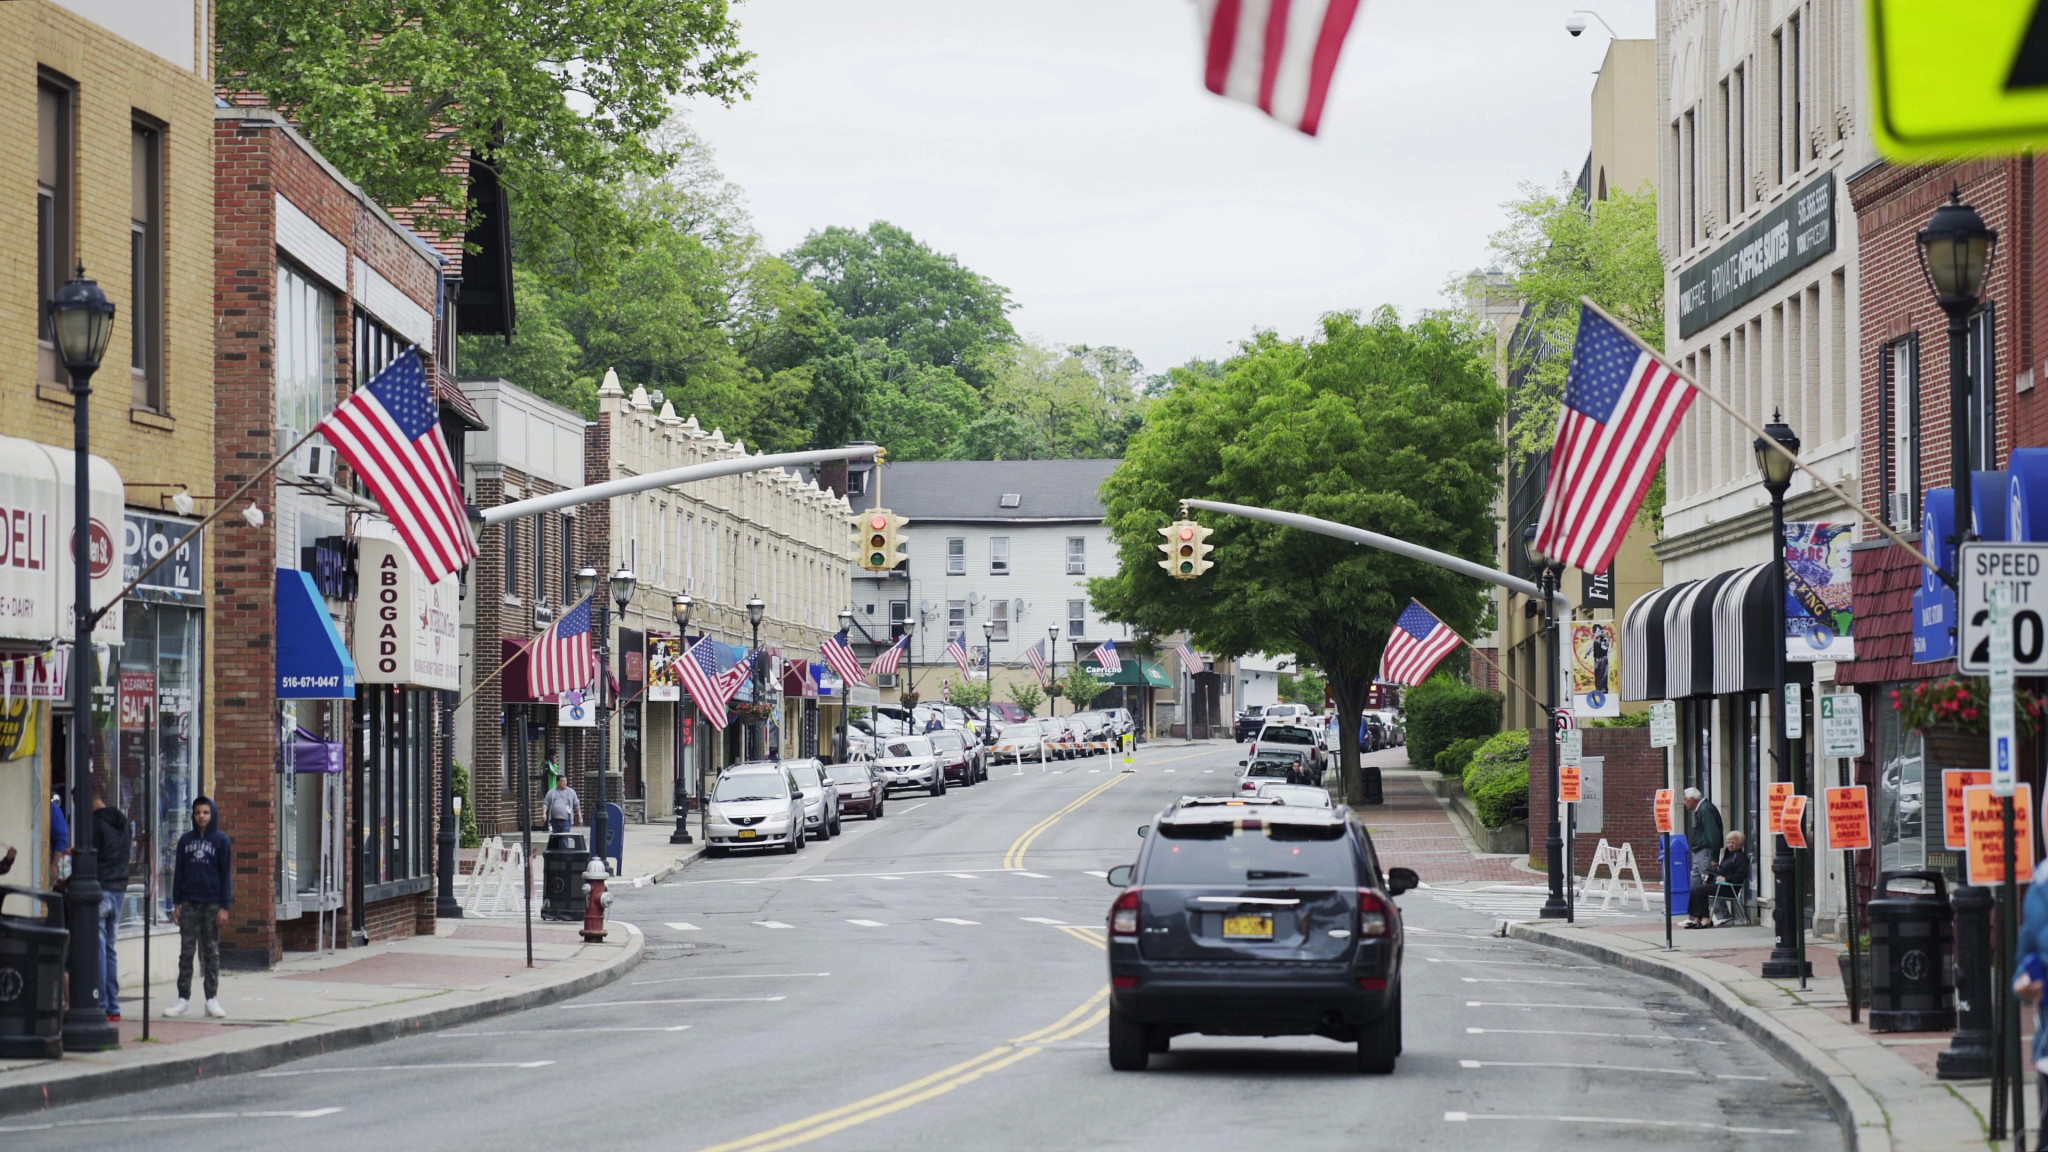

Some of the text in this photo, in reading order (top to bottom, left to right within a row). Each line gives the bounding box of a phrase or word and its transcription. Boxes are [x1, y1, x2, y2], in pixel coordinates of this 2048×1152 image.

[1711, 254, 1738, 303] PRIVATE
[1738, 236, 1763, 287] OFFICE
[1763, 219, 1789, 270] SUITES
[1976, 553, 2040, 576] SPEED
[1983, 581, 2032, 603] LIT
[12, 598, 34, 618] DAIRY
[379, 554, 398, 673] ABOGADO
[1970, 609, 2044, 665] 20
[123, 678, 153, 691] CLEARANCE
[282, 675, 340, 688] 516-671-0447
[122, 695, 154, 723] SAL!
[1823, 700, 1832, 717] 2
[1776, 786, 1784, 794] NO
[1840, 790, 1851, 800] NO
[1830, 800, 1864, 810] PARKING
[1970, 808, 2026, 822] PARKG
